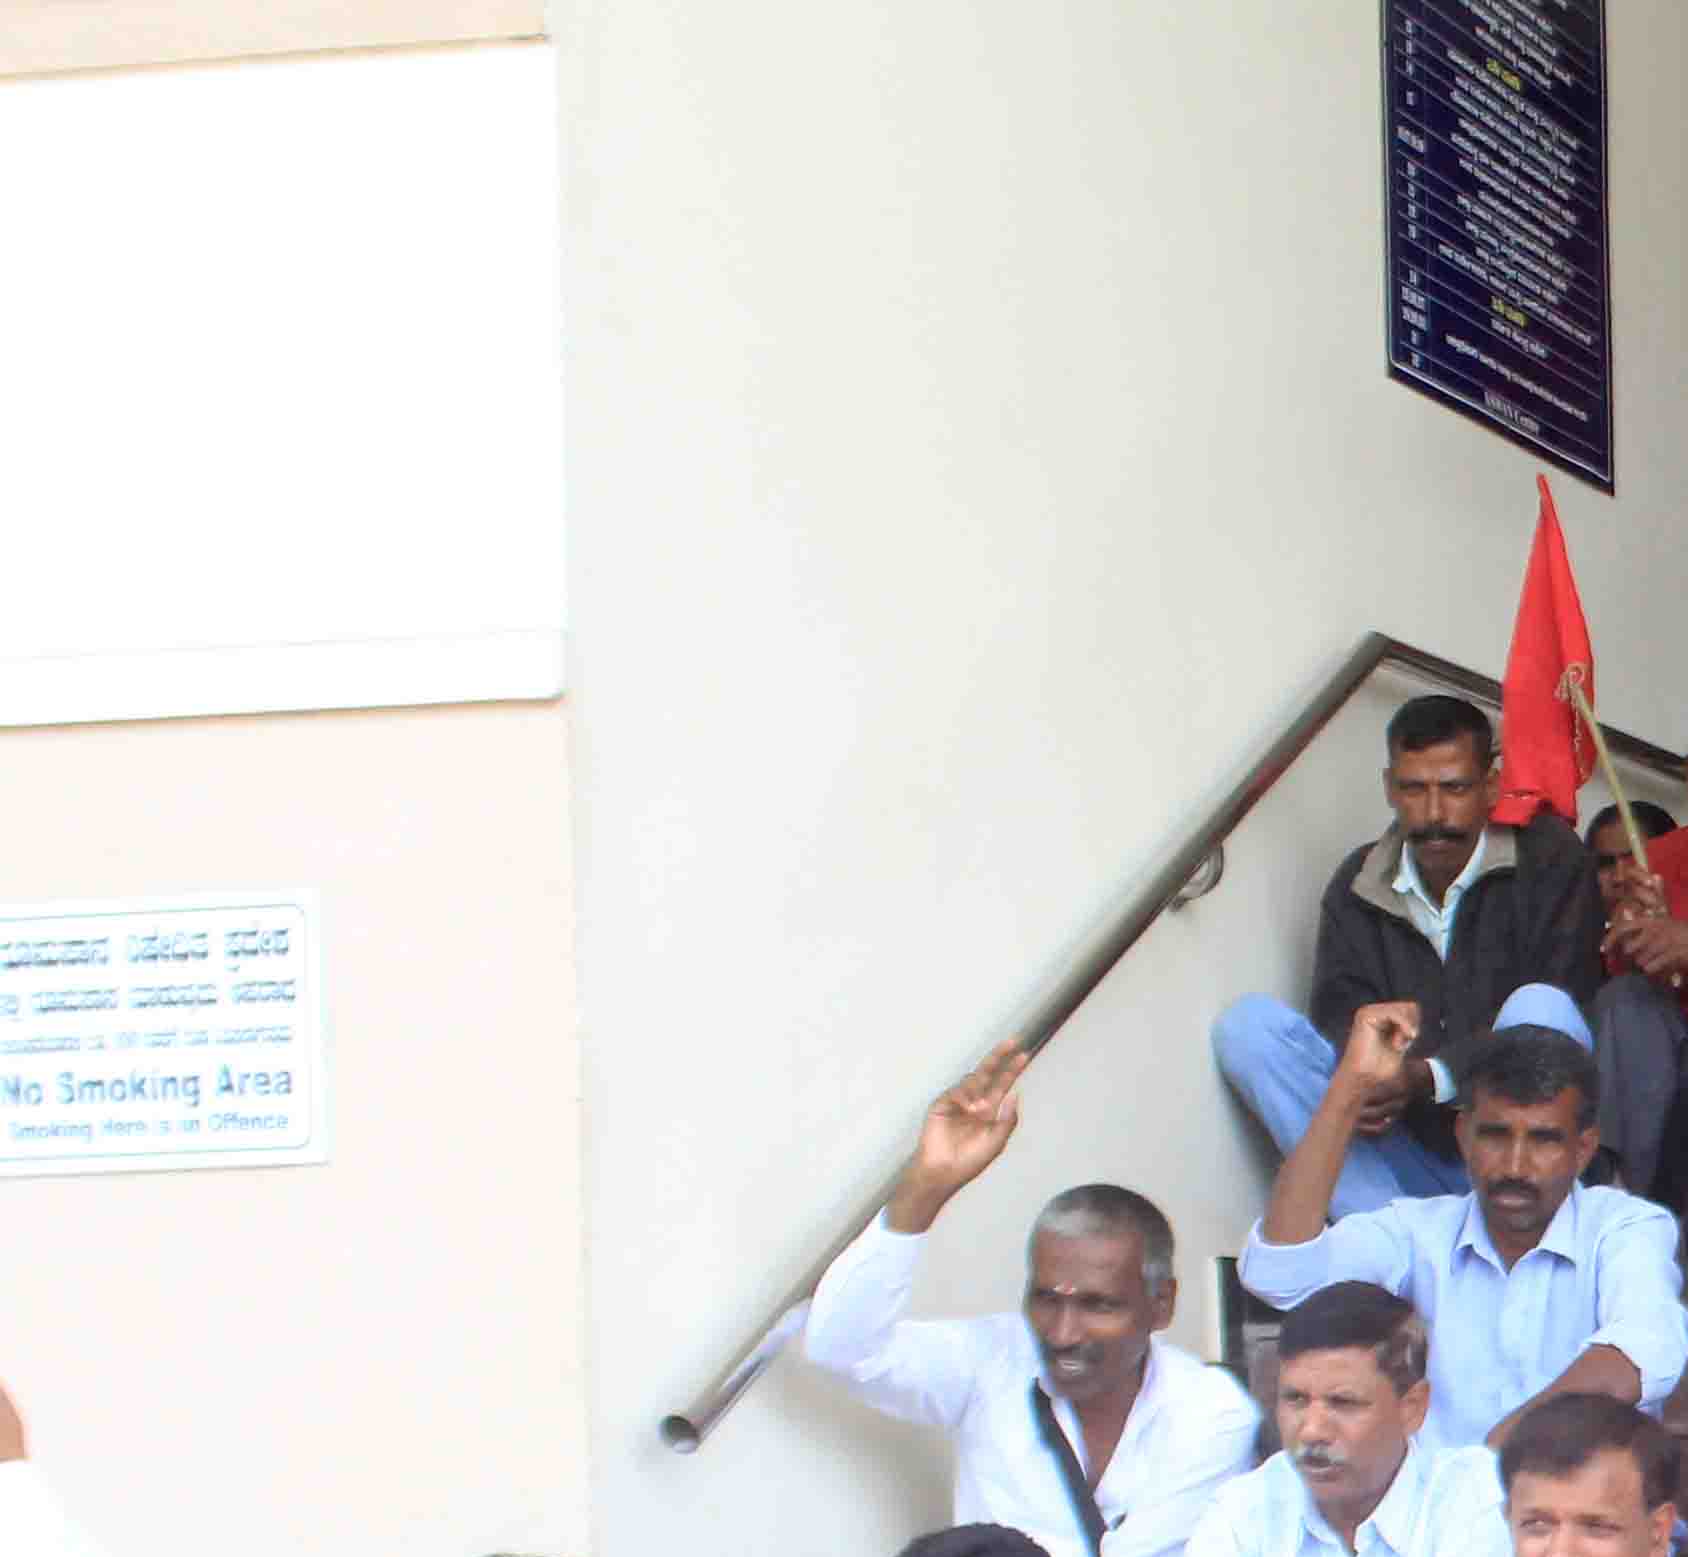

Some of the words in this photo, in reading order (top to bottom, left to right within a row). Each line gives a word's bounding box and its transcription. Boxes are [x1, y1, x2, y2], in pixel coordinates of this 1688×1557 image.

[0, 1072, 44, 1106] No
[56, 1067, 201, 1109] Smoking
[215, 1064, 293, 1096] Area
